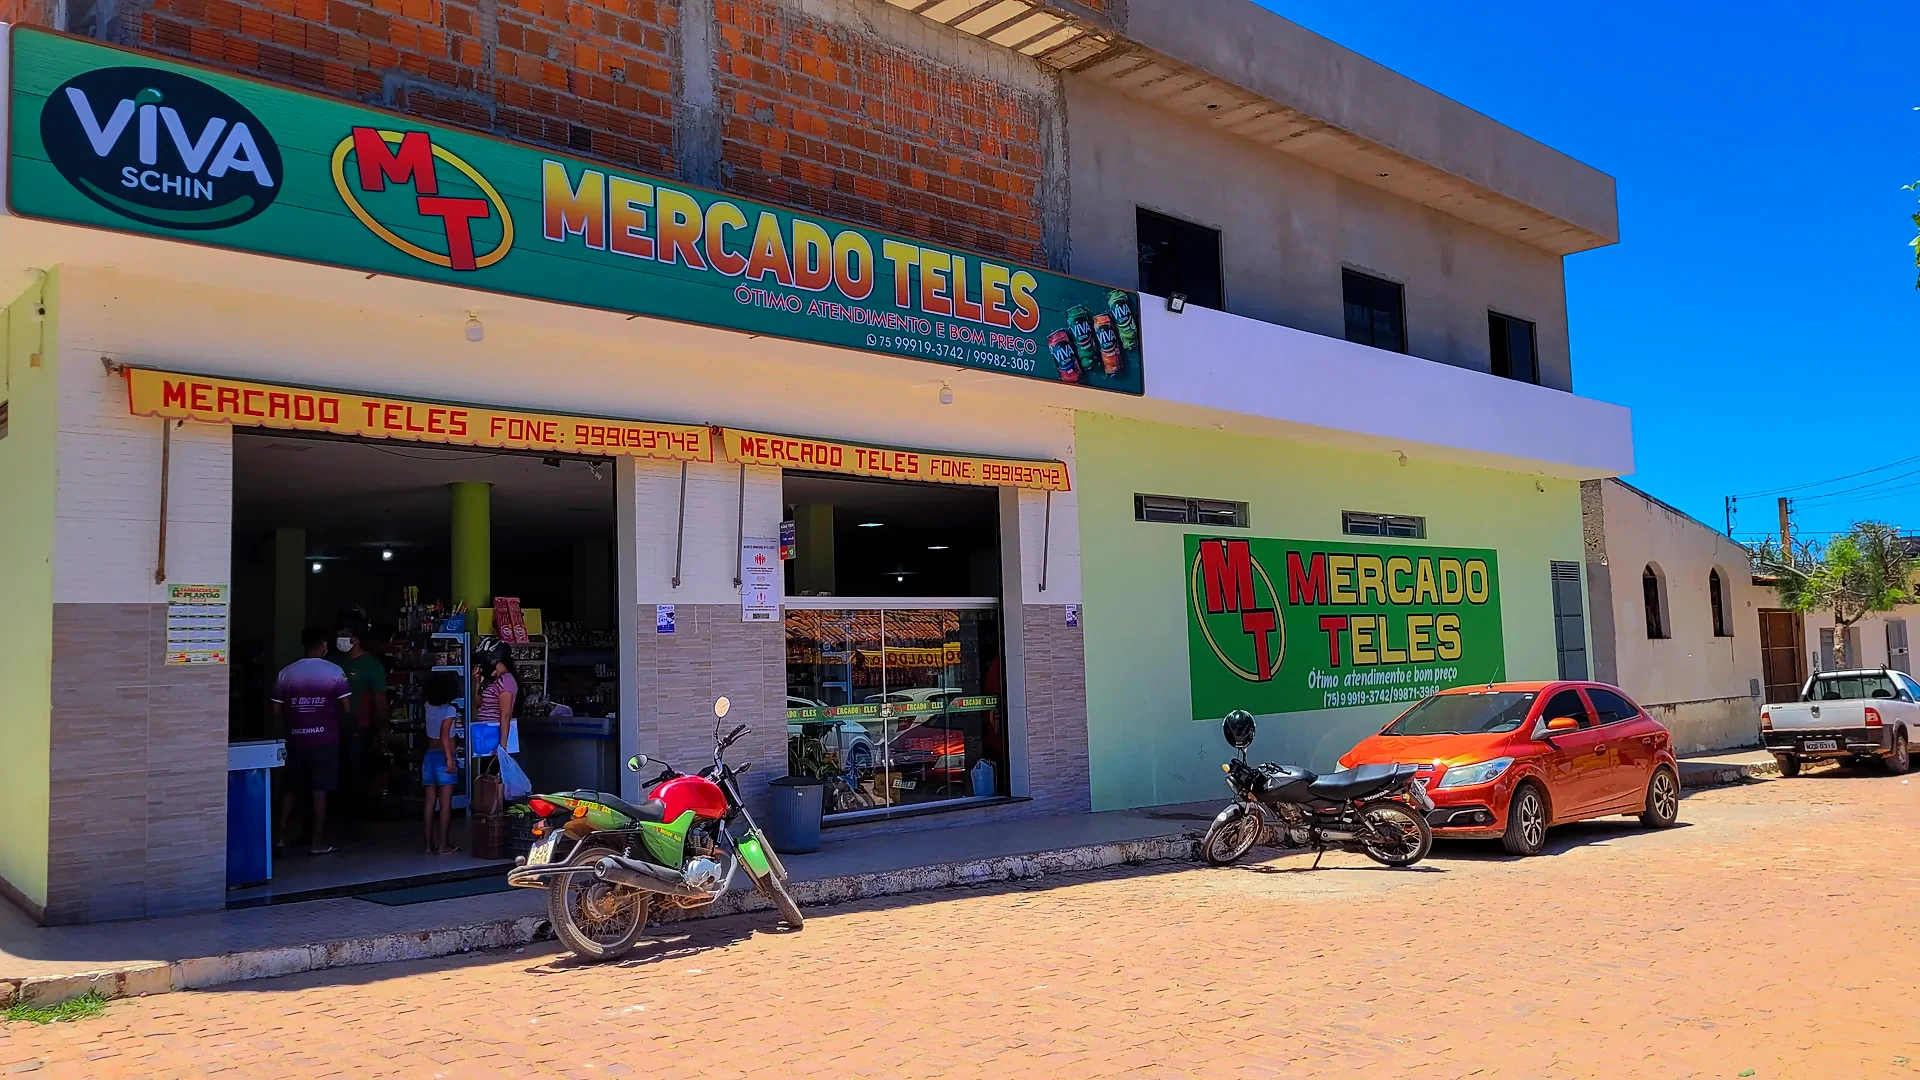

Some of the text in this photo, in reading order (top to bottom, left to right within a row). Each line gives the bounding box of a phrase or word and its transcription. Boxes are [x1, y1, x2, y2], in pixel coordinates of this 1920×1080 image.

[120, 165, 214, 201] SCHIN
[541, 158, 1041, 333] MERCADO TELES
[734, 282, 1037, 357] ÓTIMO ATENDIMENTO E BOM PREÇO
[879, 335, 892, 348] 75
[894, 336, 964, 360] 99919-3742
[973, 350, 1036, 372] 99982-3087
[161, 380, 699, 452] MERCADO TELES FONE: 999193742
[740, 436, 1061, 485] MERCADO TELES FONE: 999193742
[1286, 551, 1490, 605] MERCADO
[1318, 613, 1463, 668] TELES
[1307, 666, 1458, 689] Ótimo atendimento e bom preço
[1323, 690, 1340, 708] (75)
[1364, 789, 1390, 802] HONDA
